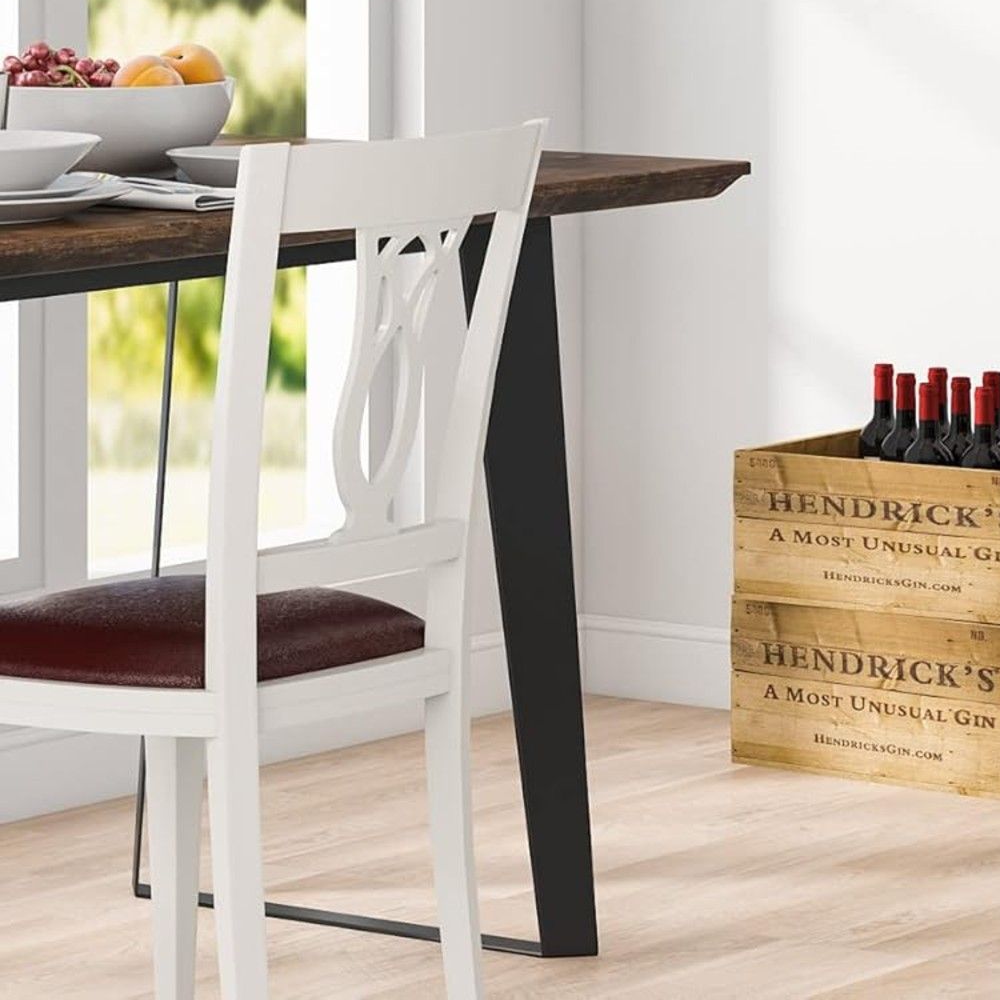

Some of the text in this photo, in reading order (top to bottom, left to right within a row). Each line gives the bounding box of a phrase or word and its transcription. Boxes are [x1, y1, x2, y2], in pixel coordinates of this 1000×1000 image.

[769, 528, 785, 542] A
[761, 642, 997, 693] HENDRICK'S
[763, 684, 779, 700] A
